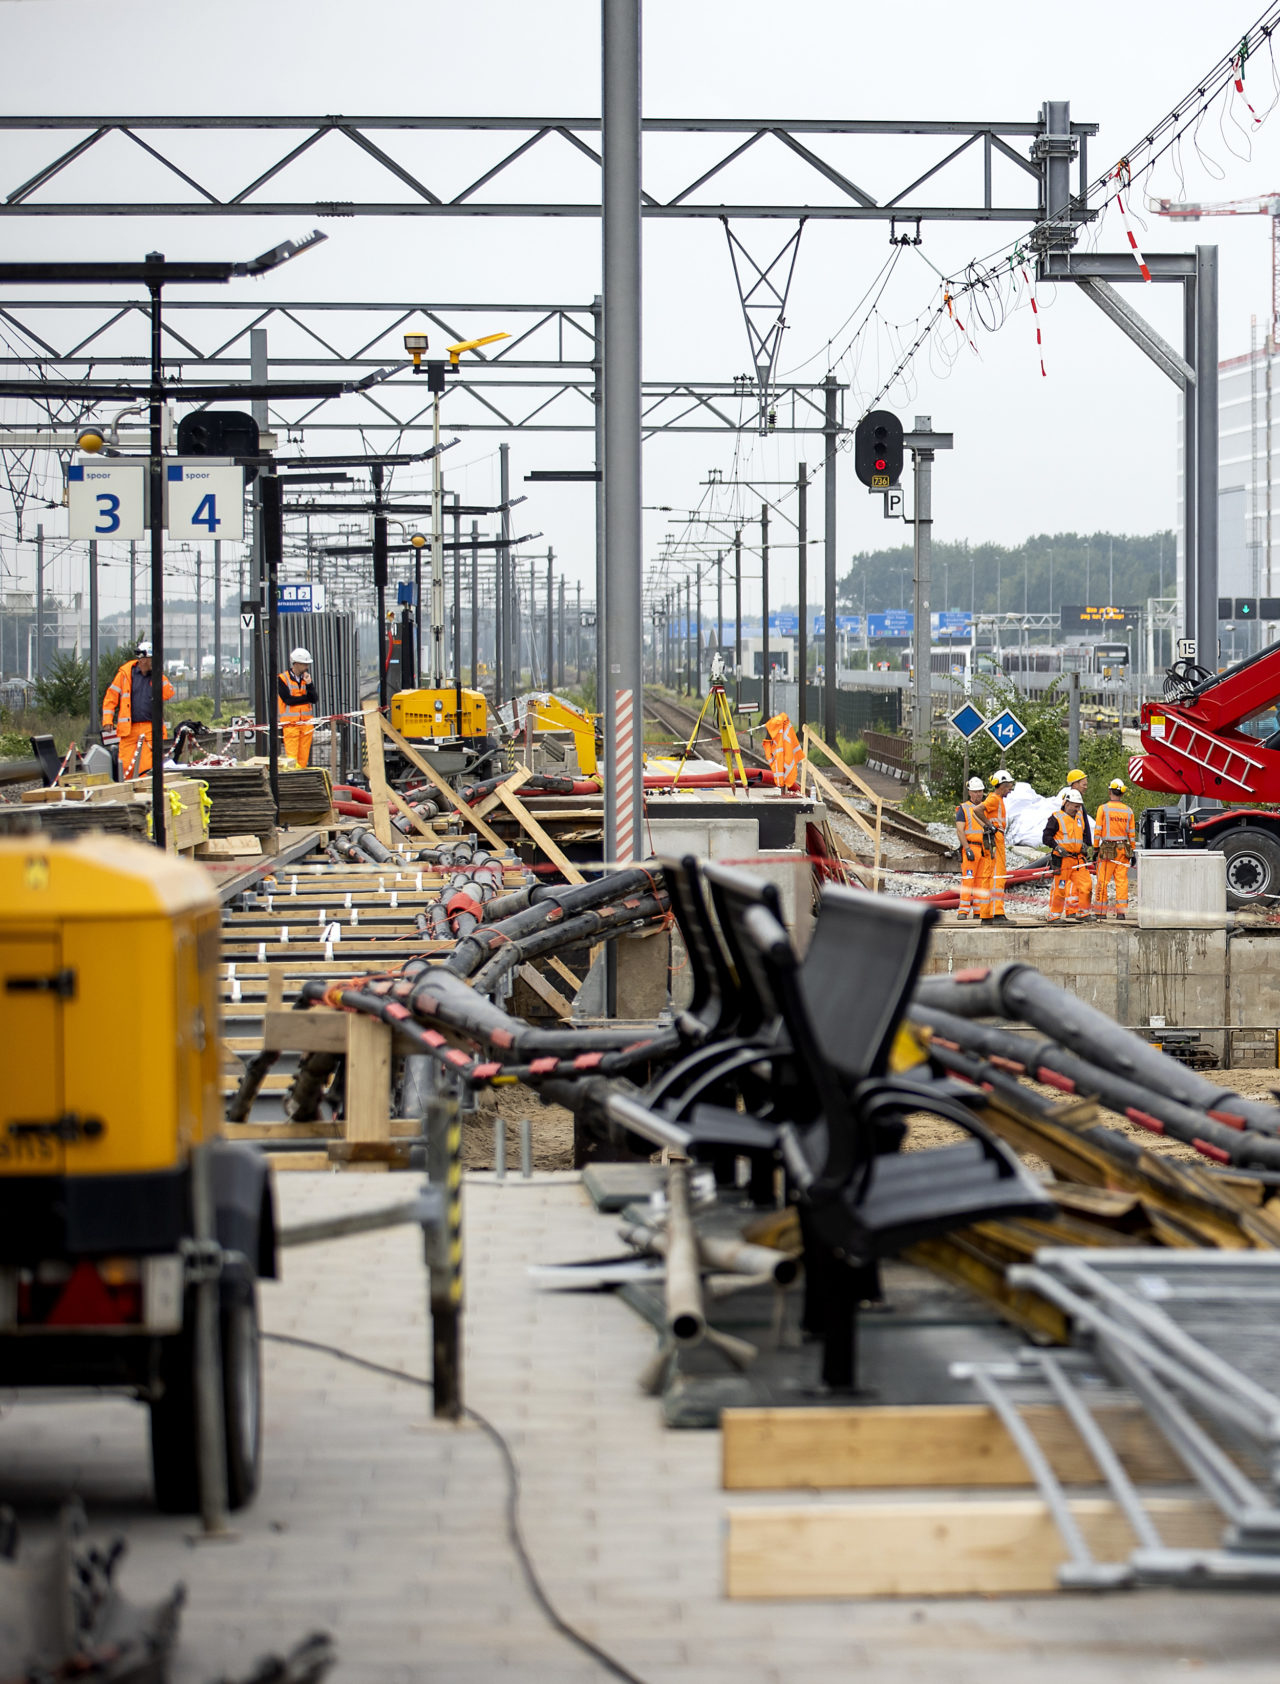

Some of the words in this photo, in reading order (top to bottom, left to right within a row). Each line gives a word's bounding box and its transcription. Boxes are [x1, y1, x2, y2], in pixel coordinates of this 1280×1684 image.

[86, 472, 111, 480] spoor
[185, 471, 210, 480] spoor
[874, 477, 888, 485] 736
[890, 495, 901, 511] P
[95, 493, 121, 534] 3
[191, 493, 221, 533] 4
[242, 615, 253, 628] V
[996, 723, 1015, 738] 14
